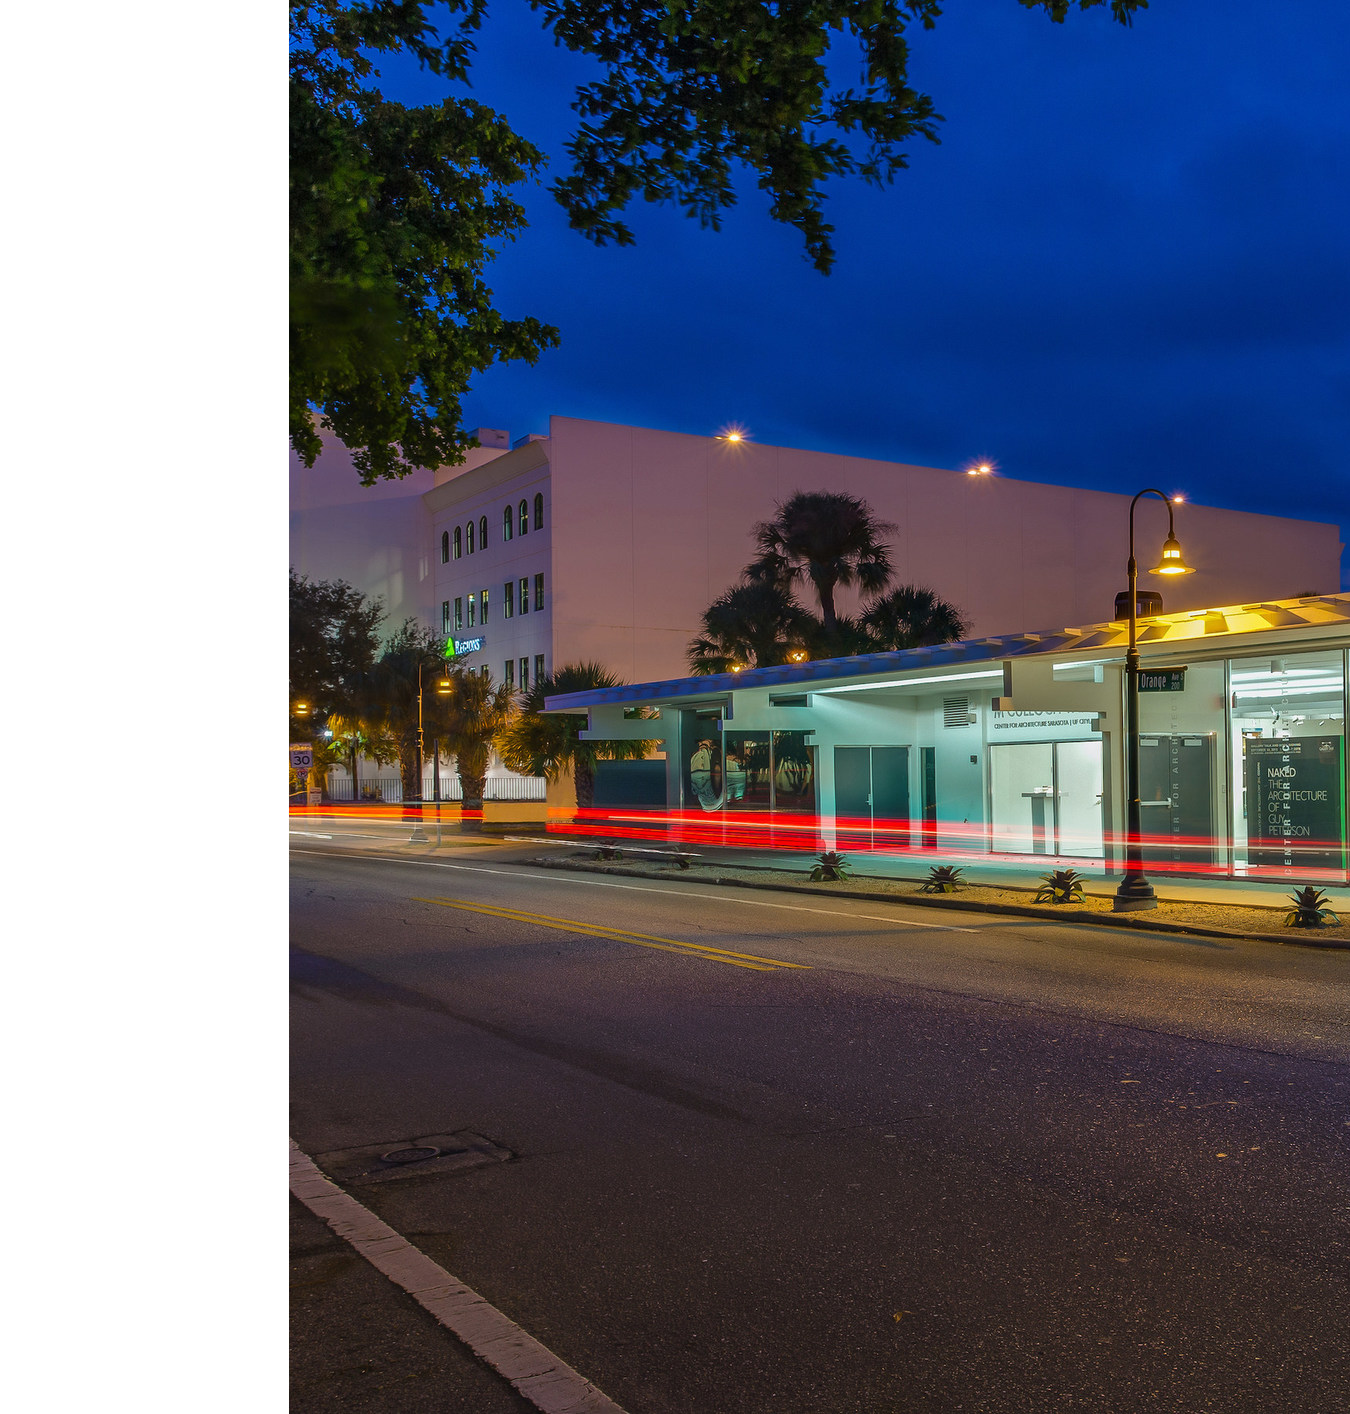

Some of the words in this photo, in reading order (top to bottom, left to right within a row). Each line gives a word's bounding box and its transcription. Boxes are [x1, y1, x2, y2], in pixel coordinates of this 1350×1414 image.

[1141, 673, 1167, 691] Orange
[1171, 682, 1180, 690] 200
[294, 755, 310, 766] 30
[1267, 767, 1297, 778] NAKED
[1268, 779, 1283, 789] THE
[1172, 783, 1180, 808] FOR
[1267, 790, 1328, 801] ARCITECTURE
[1268, 802, 1280, 812] OF
[1268, 814, 1286, 824] GUY
